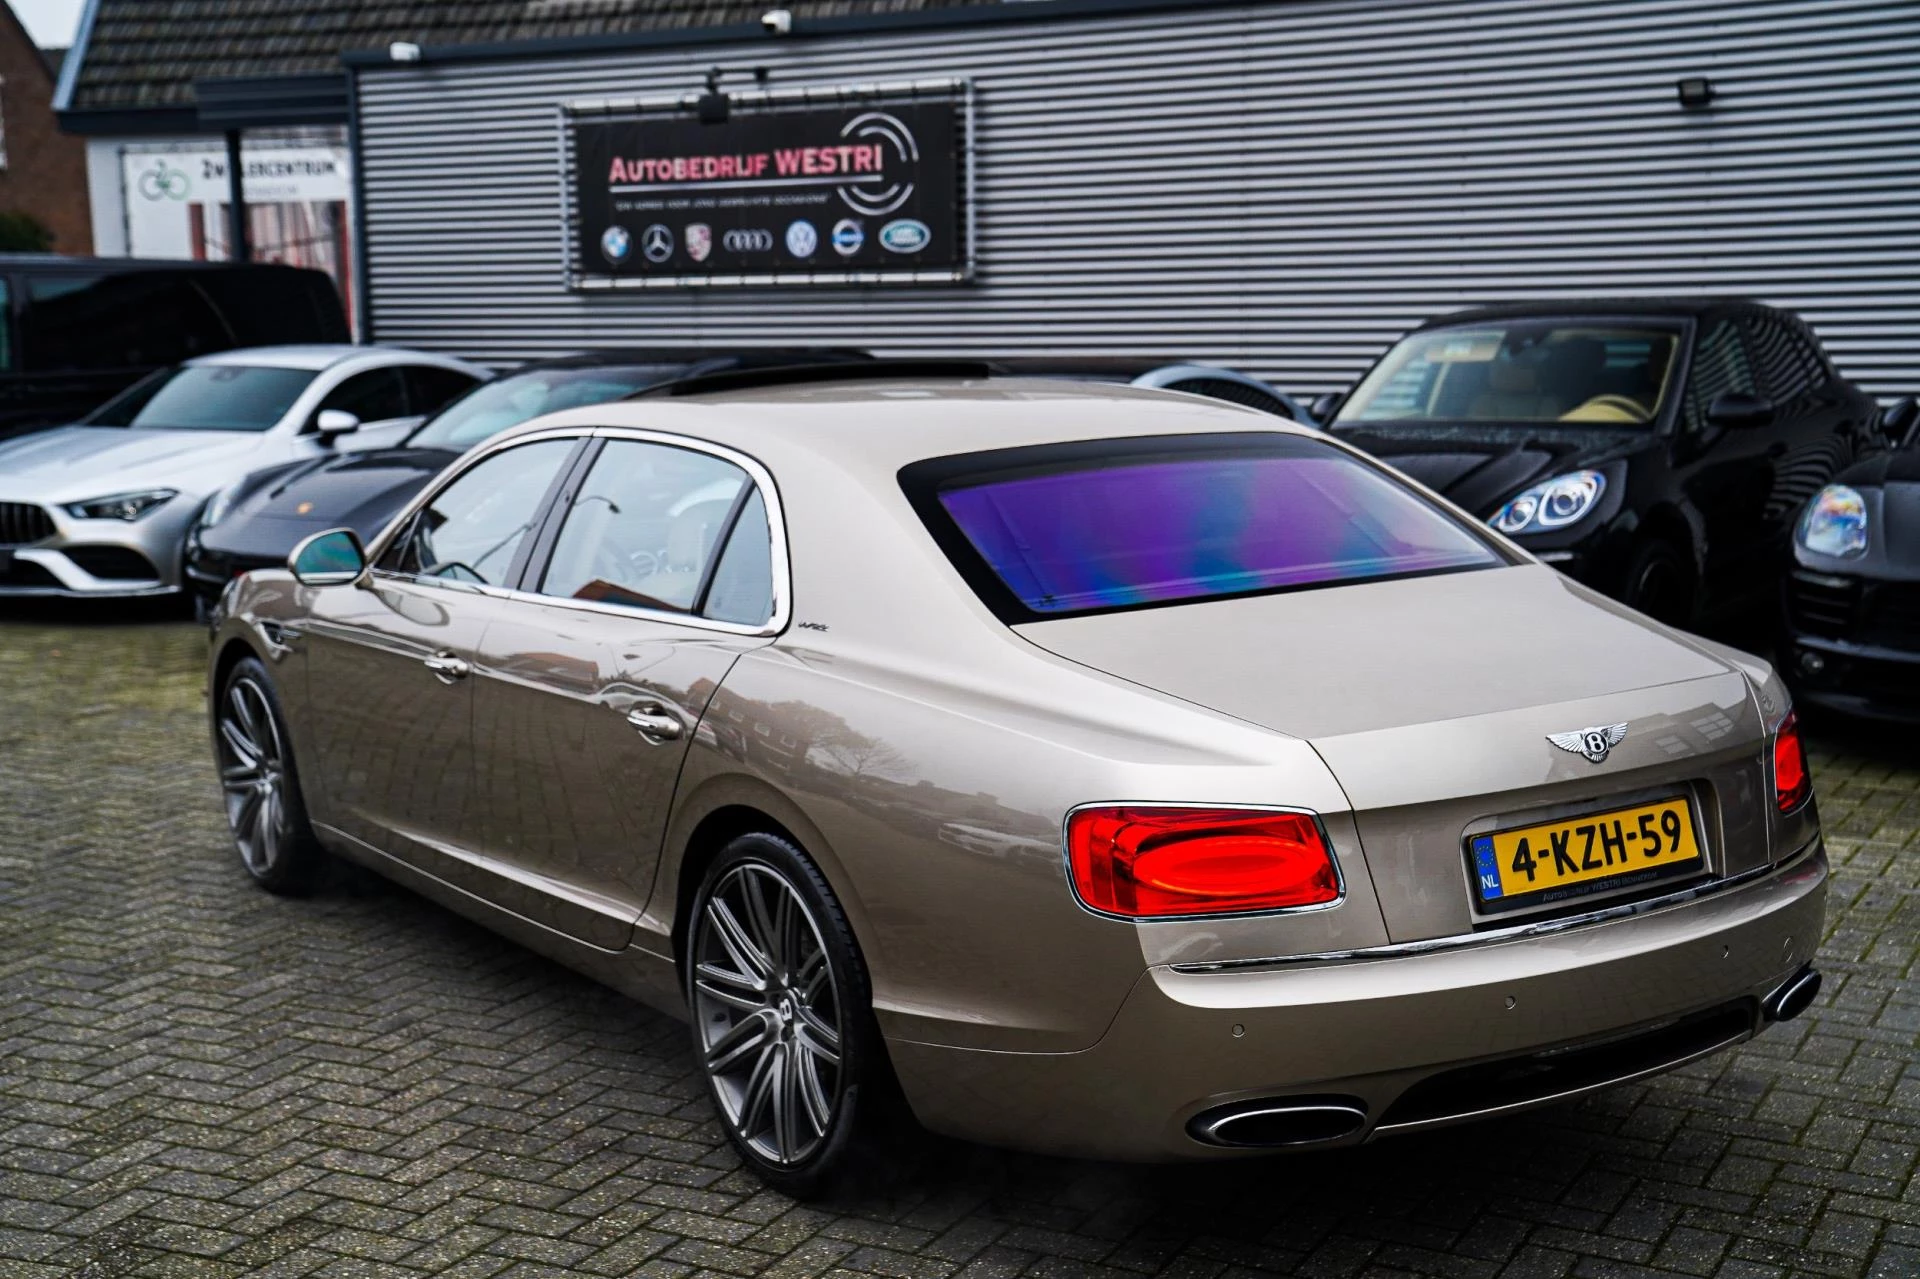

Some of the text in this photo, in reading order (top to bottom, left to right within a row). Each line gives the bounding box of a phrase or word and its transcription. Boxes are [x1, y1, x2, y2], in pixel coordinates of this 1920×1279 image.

[774, 143, 883, 174] WESTRI
[1511, 809, 1682, 882] 4-KZH-59
[1481, 874, 1499, 890] NL
